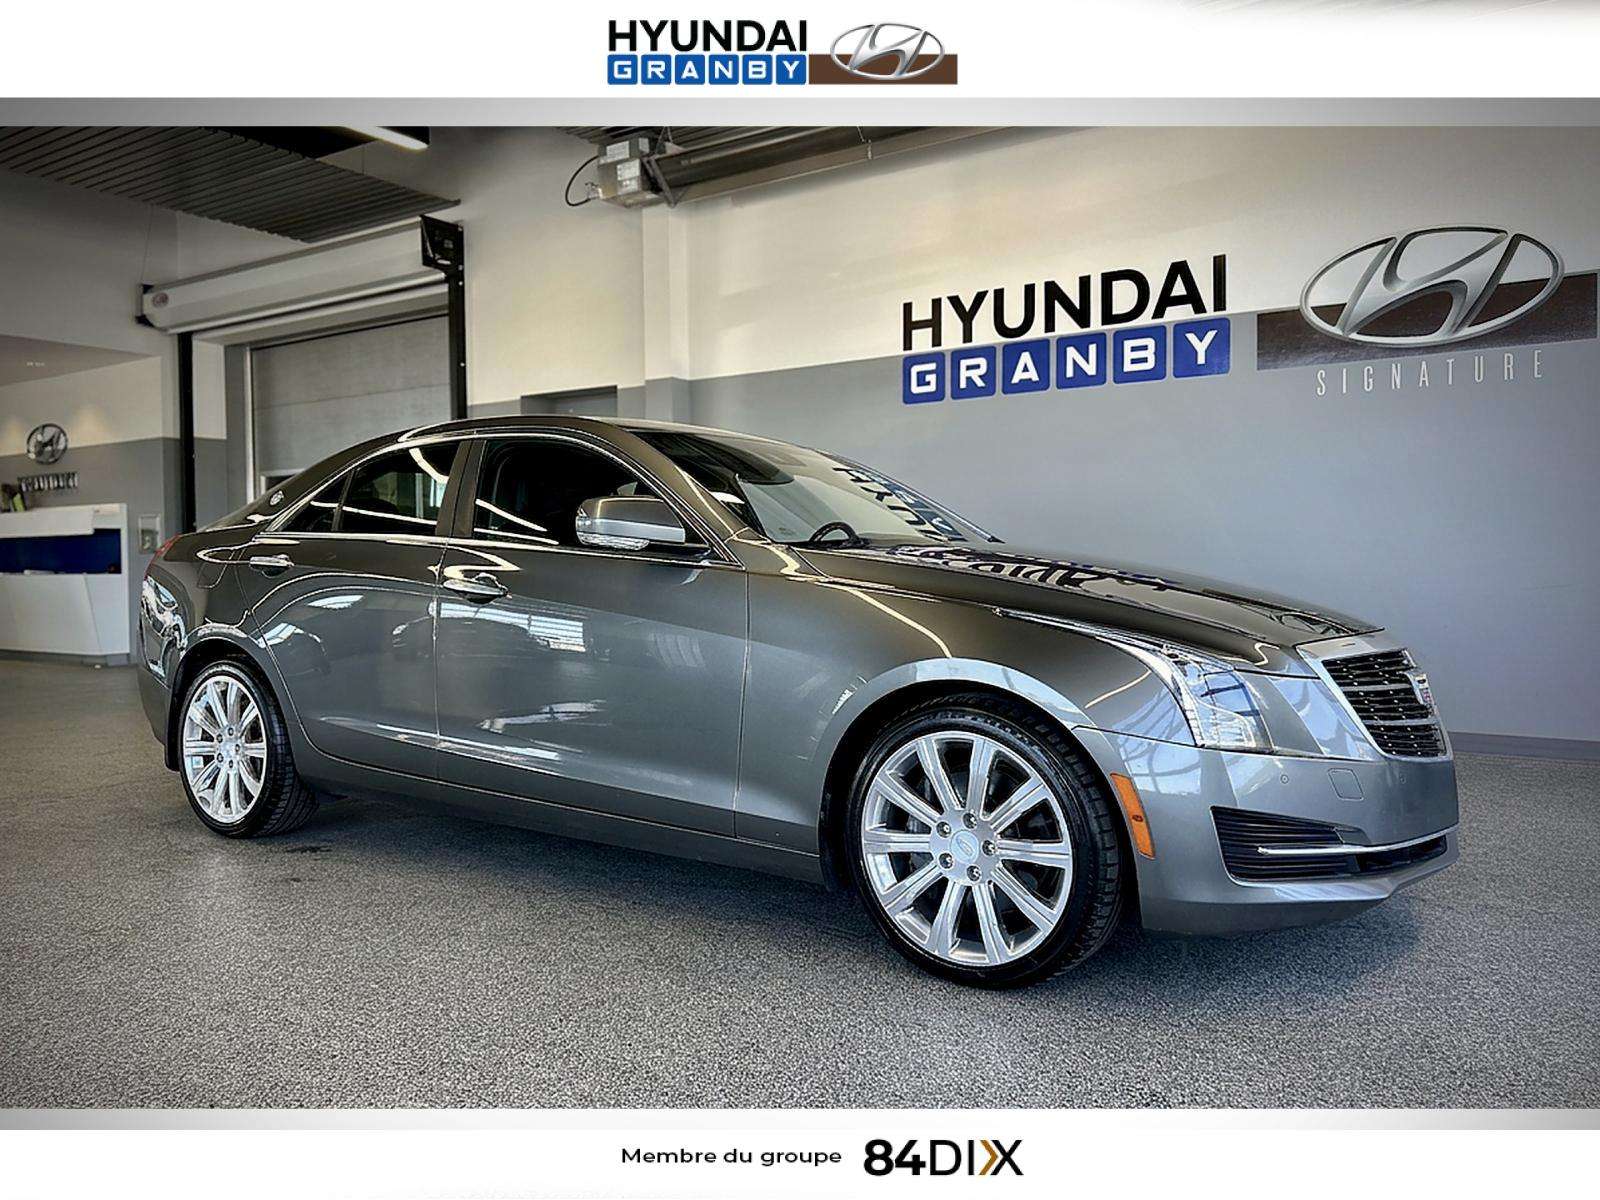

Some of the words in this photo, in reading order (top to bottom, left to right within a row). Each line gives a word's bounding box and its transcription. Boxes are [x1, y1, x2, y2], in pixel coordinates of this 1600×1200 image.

[902, 253, 1227, 351] HYUNDAI
[910, 329, 1219, 395] GRANBY
[1316, 350, 1543, 396] SIGNATURE
